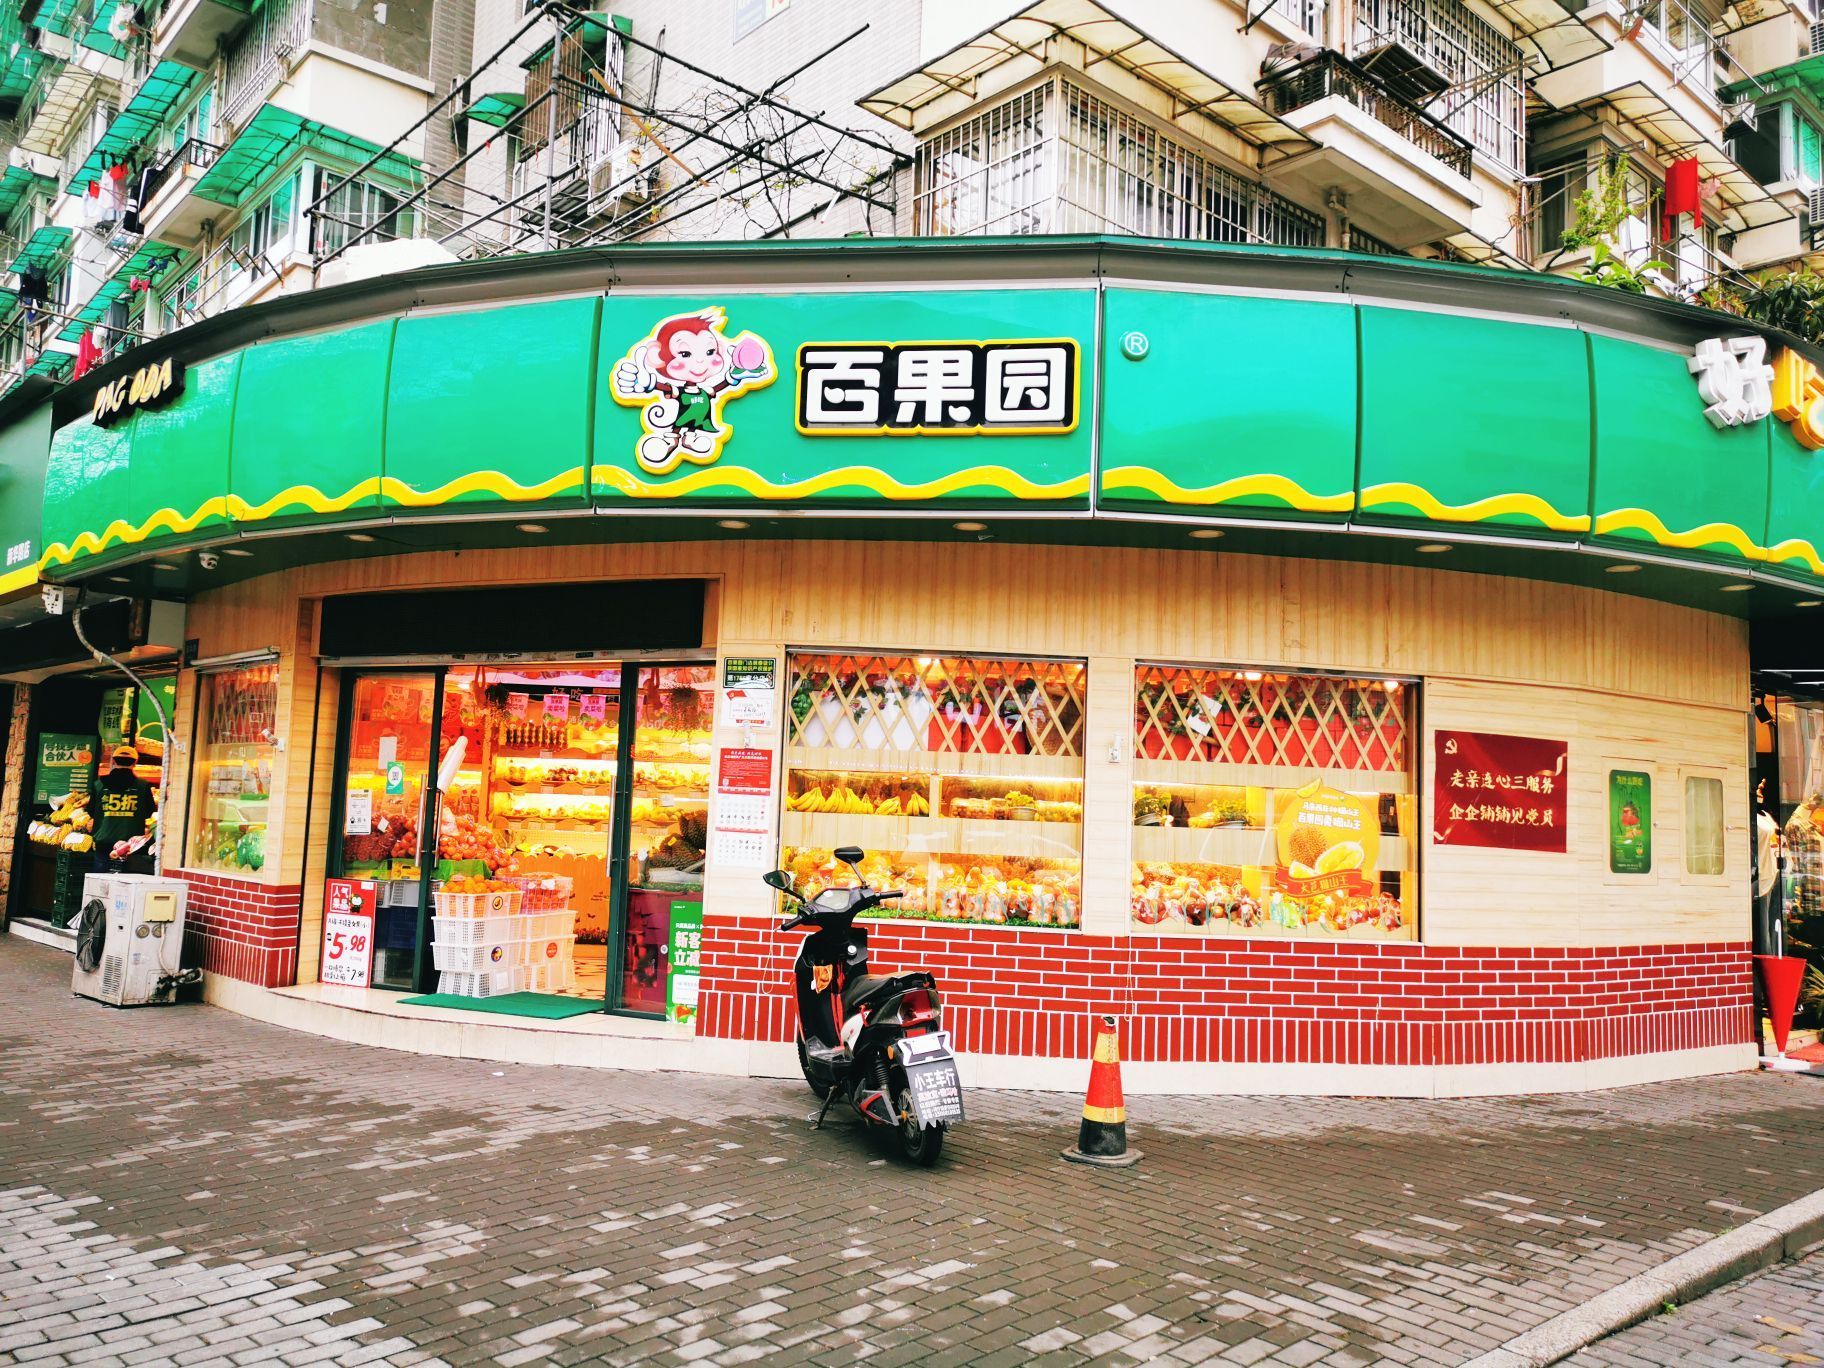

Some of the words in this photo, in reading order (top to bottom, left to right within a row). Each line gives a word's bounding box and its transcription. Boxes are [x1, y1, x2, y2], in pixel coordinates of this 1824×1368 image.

[805, 347, 1066, 423] 百果园
[46, 751, 76, 761] 合伙人
[1450, 769, 1554, 794] 走亲连心三服务
[1449, 803, 1554, 828] 企企铺铺见党员
[675, 931, 701, 948] 新客
[915, 1067, 956, 1092] 小王车行
